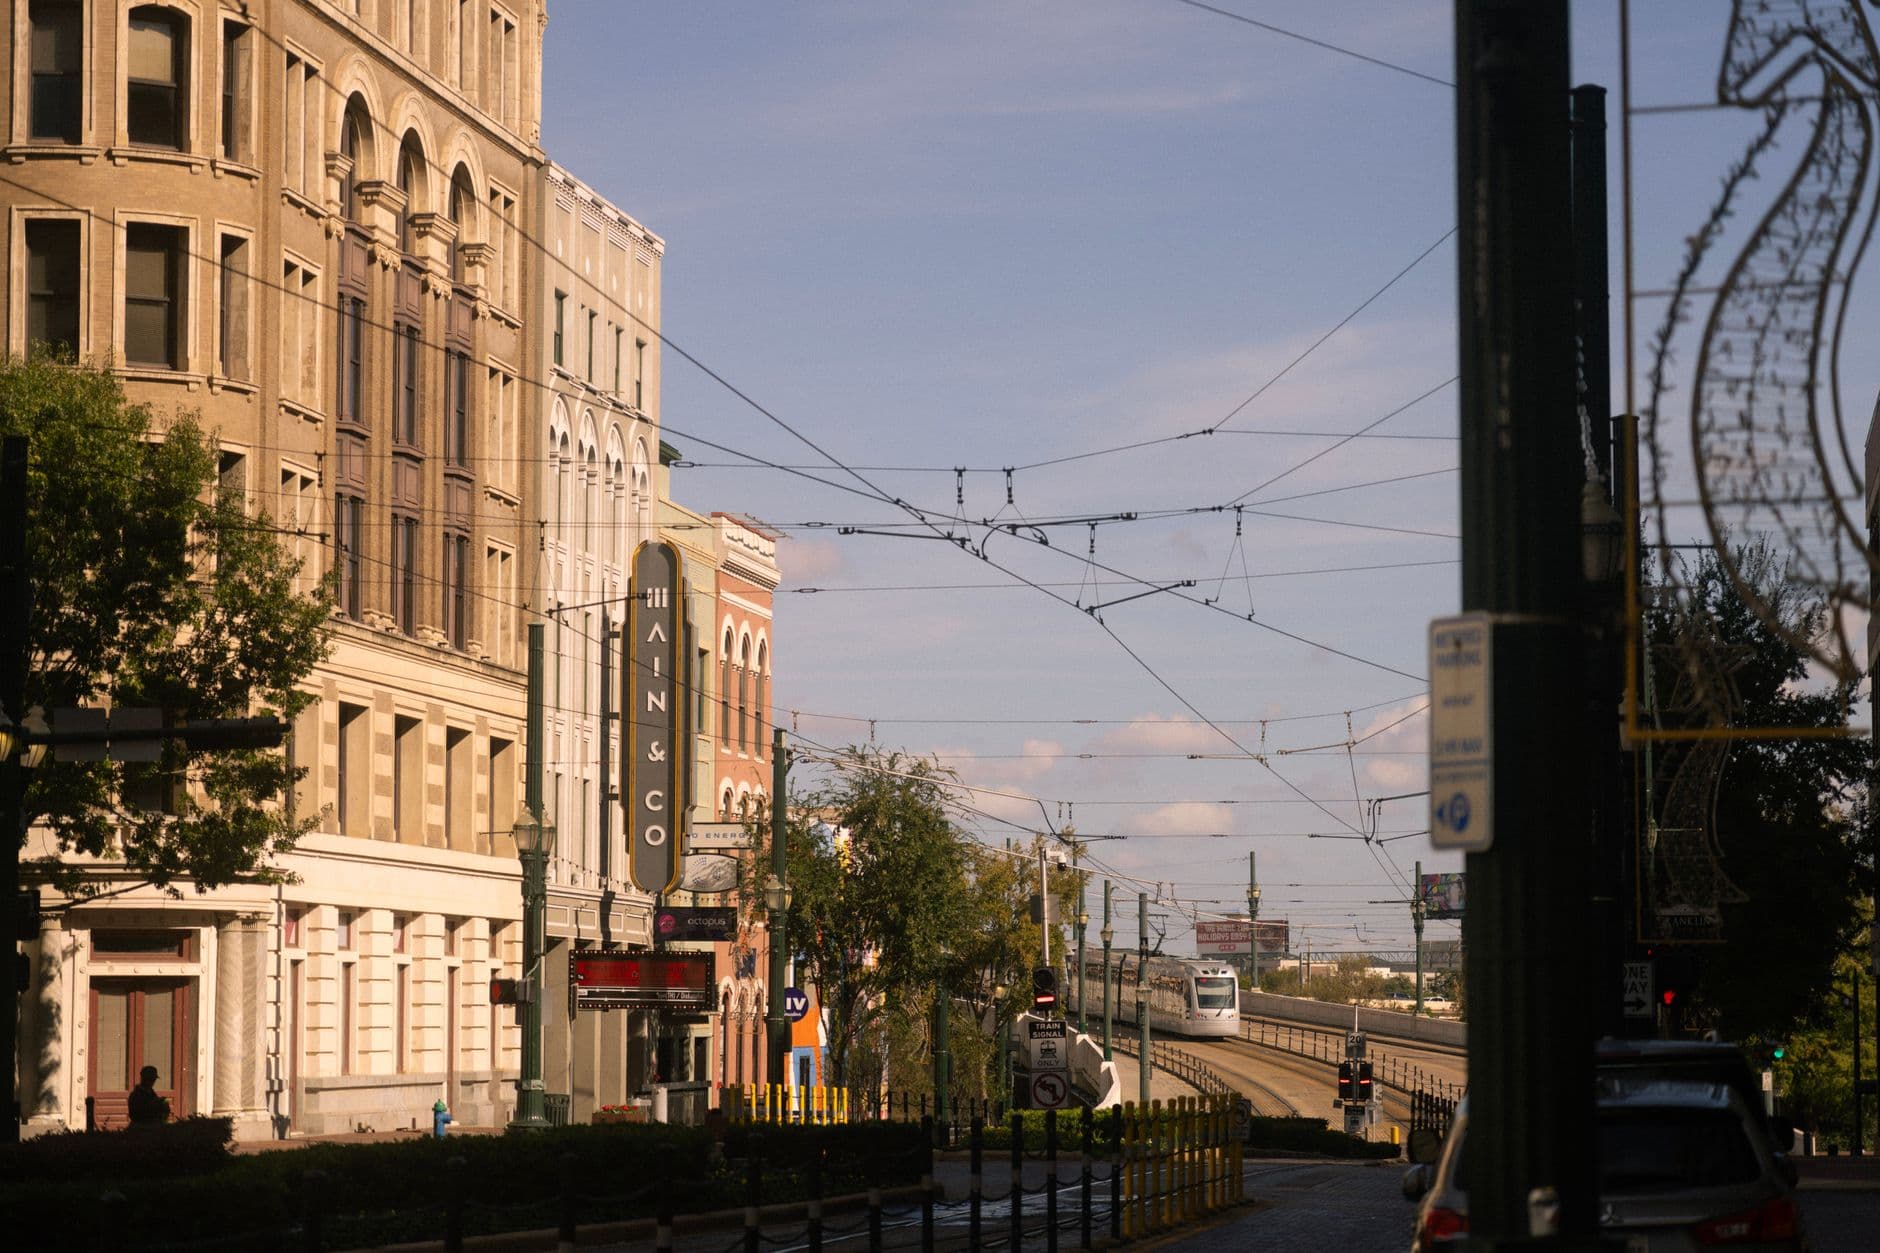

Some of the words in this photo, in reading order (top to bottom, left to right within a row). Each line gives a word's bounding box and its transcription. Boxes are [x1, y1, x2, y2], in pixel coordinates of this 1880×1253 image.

[646, 587, 668, 713] MAIN
[646, 741, 666, 762] &
[644, 789, 666, 847] CO
[1349, 1035, 1362, 1044] 20
[1036, 1059, 1060, 1067] ONLY
